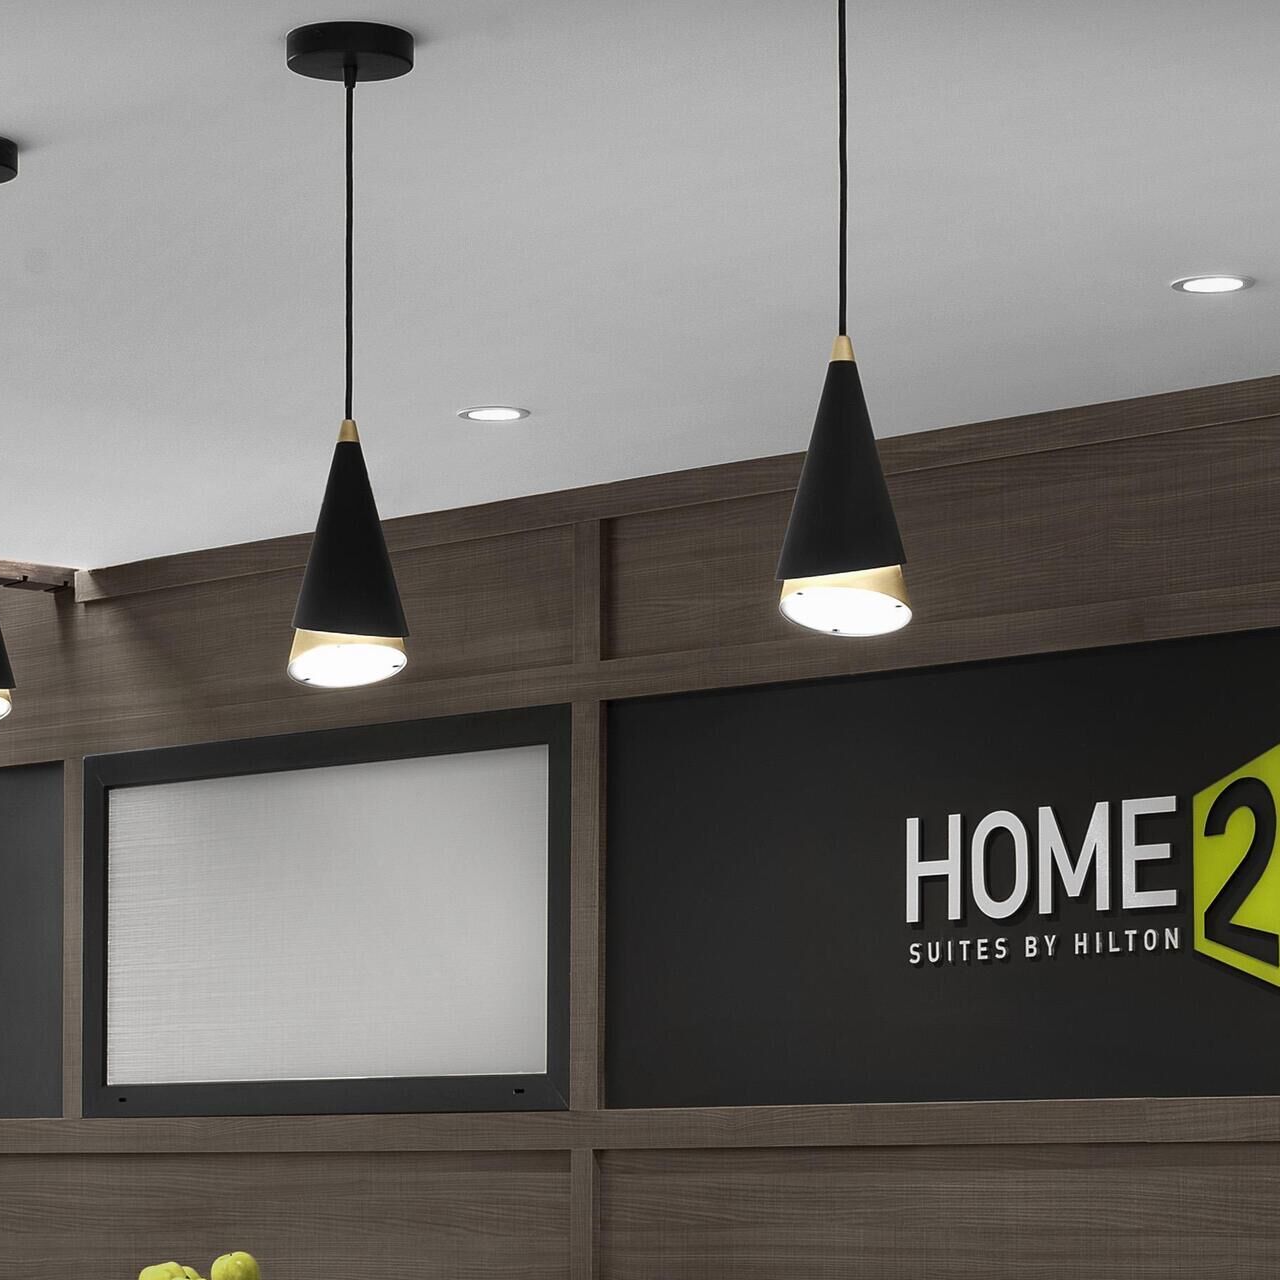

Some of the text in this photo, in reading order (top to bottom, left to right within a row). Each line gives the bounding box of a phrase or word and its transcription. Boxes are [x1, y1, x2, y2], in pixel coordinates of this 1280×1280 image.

[909, 927, 1179, 964] SUITES BY HILTON
